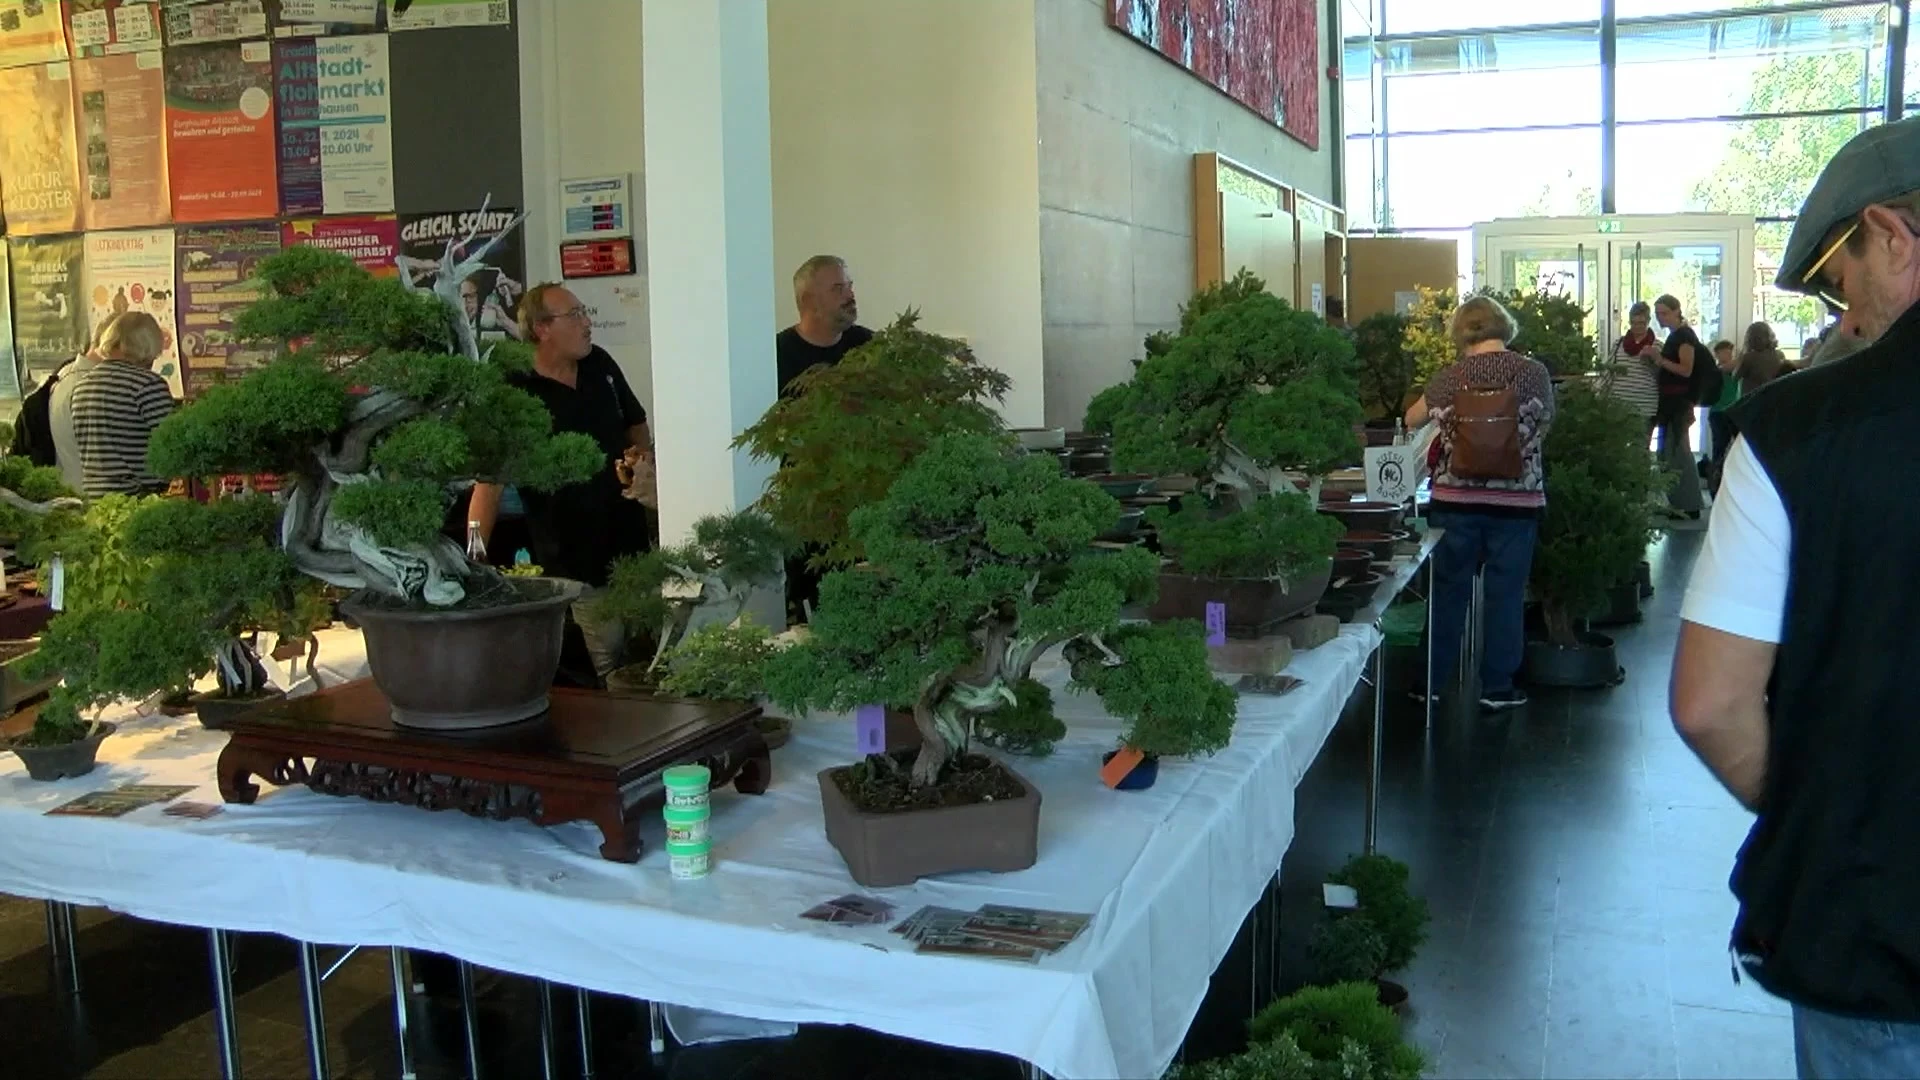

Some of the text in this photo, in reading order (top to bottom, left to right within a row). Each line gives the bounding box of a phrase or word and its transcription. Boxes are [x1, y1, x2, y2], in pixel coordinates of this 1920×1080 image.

[280, 57, 372, 79] Altstadt-
[280, 78, 385, 102] flohmarkt
[294, 103, 359, 116] Burghausen
[174, 124, 256, 137] bewahren und gestalten
[333, 128, 360, 140] 2024
[322, 143, 352, 155] 20.00
[354, 142, 373, 153] Uhr
[3, 171, 62, 195] KULTUR
[10, 189, 73, 211] KLOSTER
[401, 214, 457, 241] GLEICH,
[303, 234, 379, 248] BURGHAUSER
